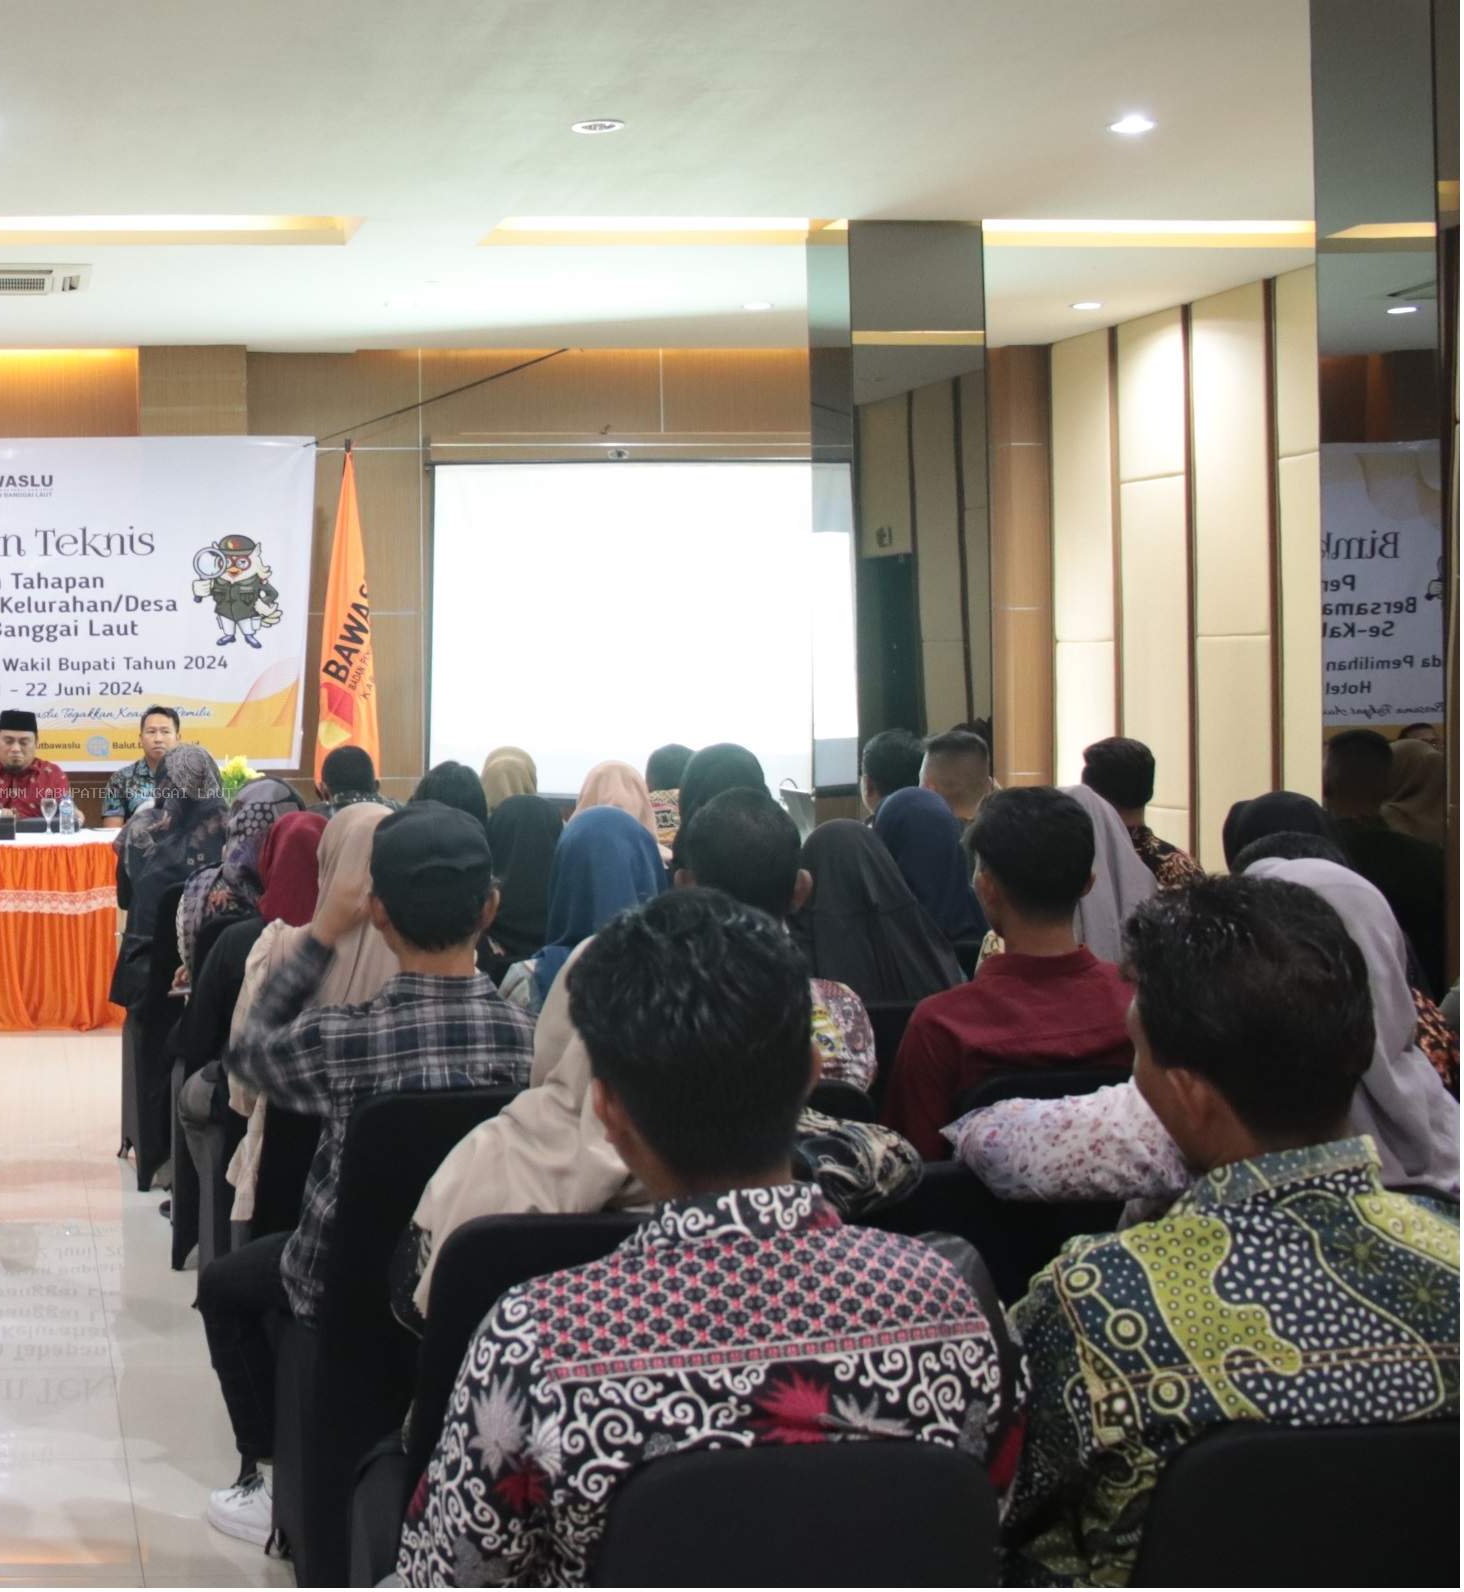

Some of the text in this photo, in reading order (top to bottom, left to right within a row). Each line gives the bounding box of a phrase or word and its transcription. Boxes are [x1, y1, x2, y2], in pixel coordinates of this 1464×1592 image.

[34, 525, 156, 559] Teknis
[11, 572, 105, 593] Tahapan
[0, 594, 178, 614] Kelurahan/Desa
[89, 619, 139, 638] Laut
[3, 657, 51, 672] Wakil
[58, 656, 116, 675] Bupati
[123, 656, 176, 671] Tahun
[184, 655, 228, 670] 2024
[25, 682, 47, 697] 22
[54, 681, 91, 697] Juni
[99, 681, 144, 696] 2024
